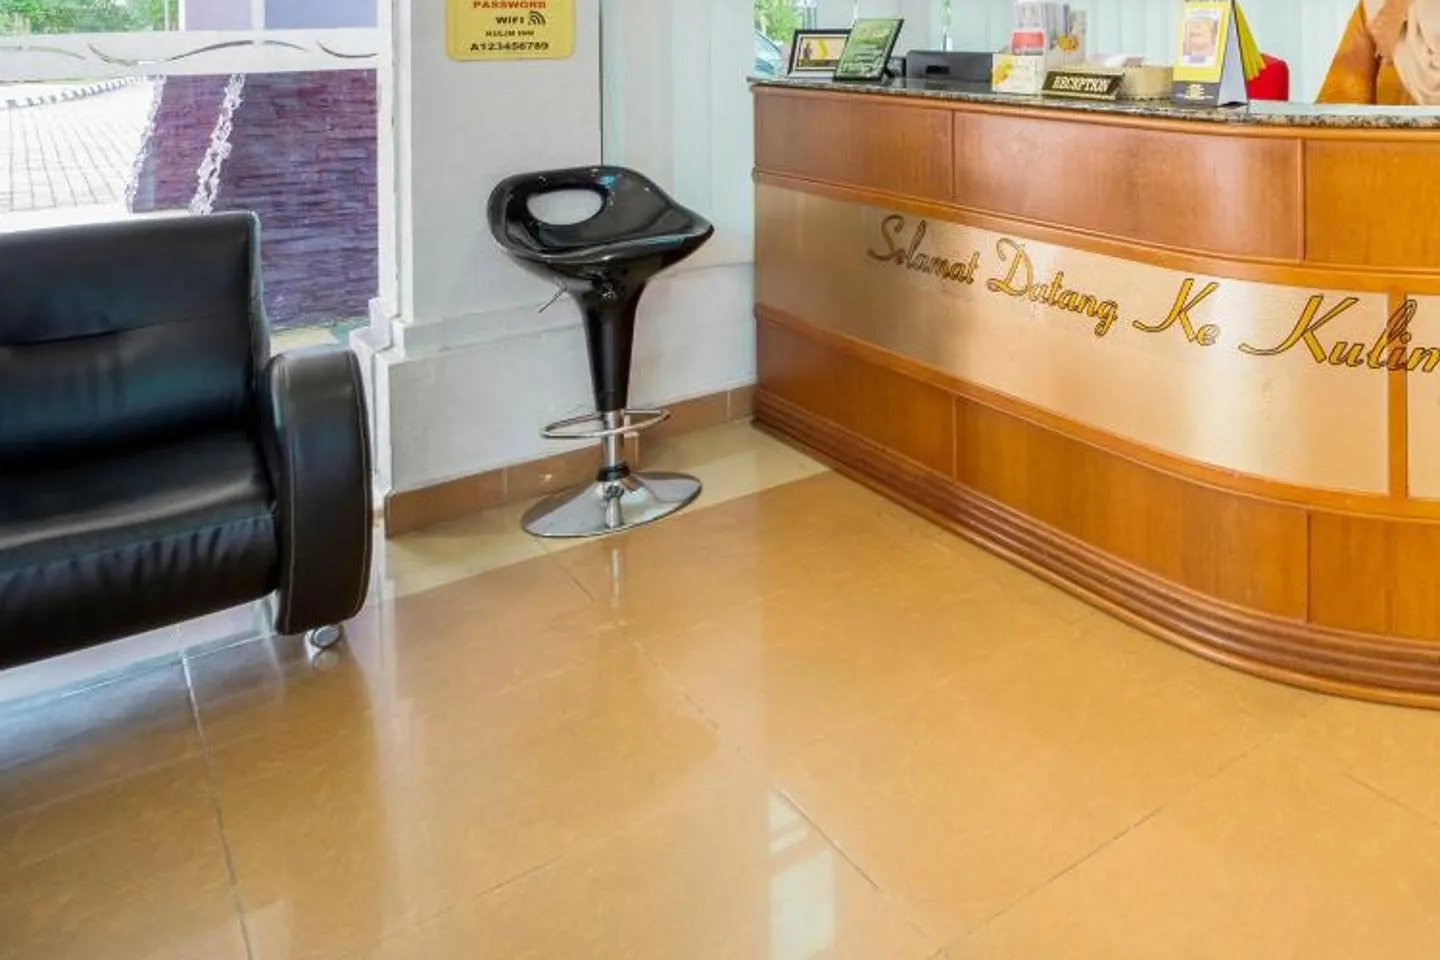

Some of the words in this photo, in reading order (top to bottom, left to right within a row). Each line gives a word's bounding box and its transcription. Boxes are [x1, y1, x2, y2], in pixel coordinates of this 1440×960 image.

[495, 16, 525, 25] WIFI
[470, 42, 550, 52] A123456789
[1051, 76, 1111, 92] RECEPTION
[867, 214, 981, 285] Selamat
[987, 238, 1119, 337] Datang
[1132, 277, 1221, 346] Ke
